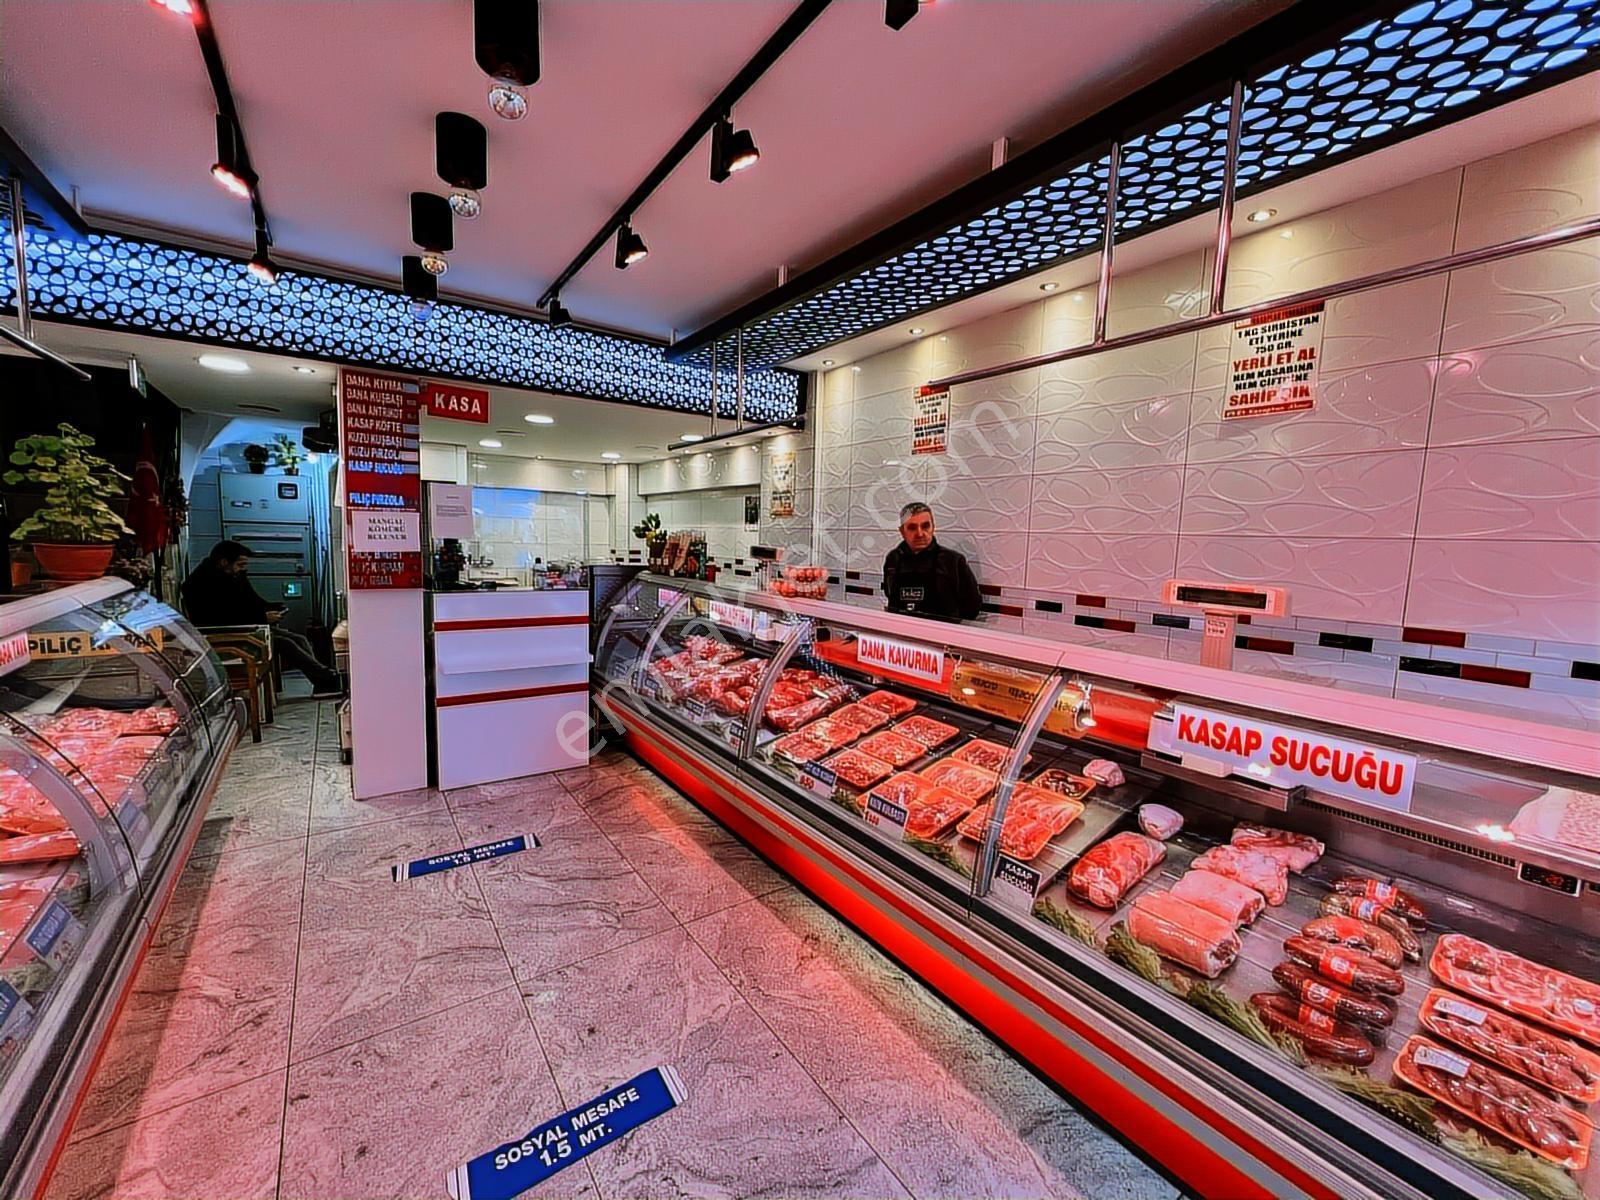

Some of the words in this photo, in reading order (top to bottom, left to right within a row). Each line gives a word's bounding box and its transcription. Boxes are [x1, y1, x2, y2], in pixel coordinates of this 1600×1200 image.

[1255, 344, 1275, 355] 750
[1276, 351, 1295, 365] ET
[1296, 347, 1317, 361] AL
[345, 374, 371, 388] DANA
[1232, 372, 1256, 382] HEM
[1234, 380, 1258, 391] HEM
[346, 388, 369, 400] DANA
[346, 402, 367, 414] DANA
[434, 391, 481, 415] KASA
[347, 416, 374, 430] KASAP
[860, 638, 886, 662] DANA
[888, 644, 939, 676] KAVURMA
[1177, 713, 1263, 758] KASAP
[1269, 735, 1404, 796] SUCUĞU
[428, 851, 469, 865] SOSYAL
[473, 840, 514, 855] MESAFE
[494, 1125, 569, 1170] SOSYAL
[570, 1087, 640, 1131] MESAFE
[539, 1139, 572, 1167] 1.5
[578, 1123, 613, 1147] MT.
